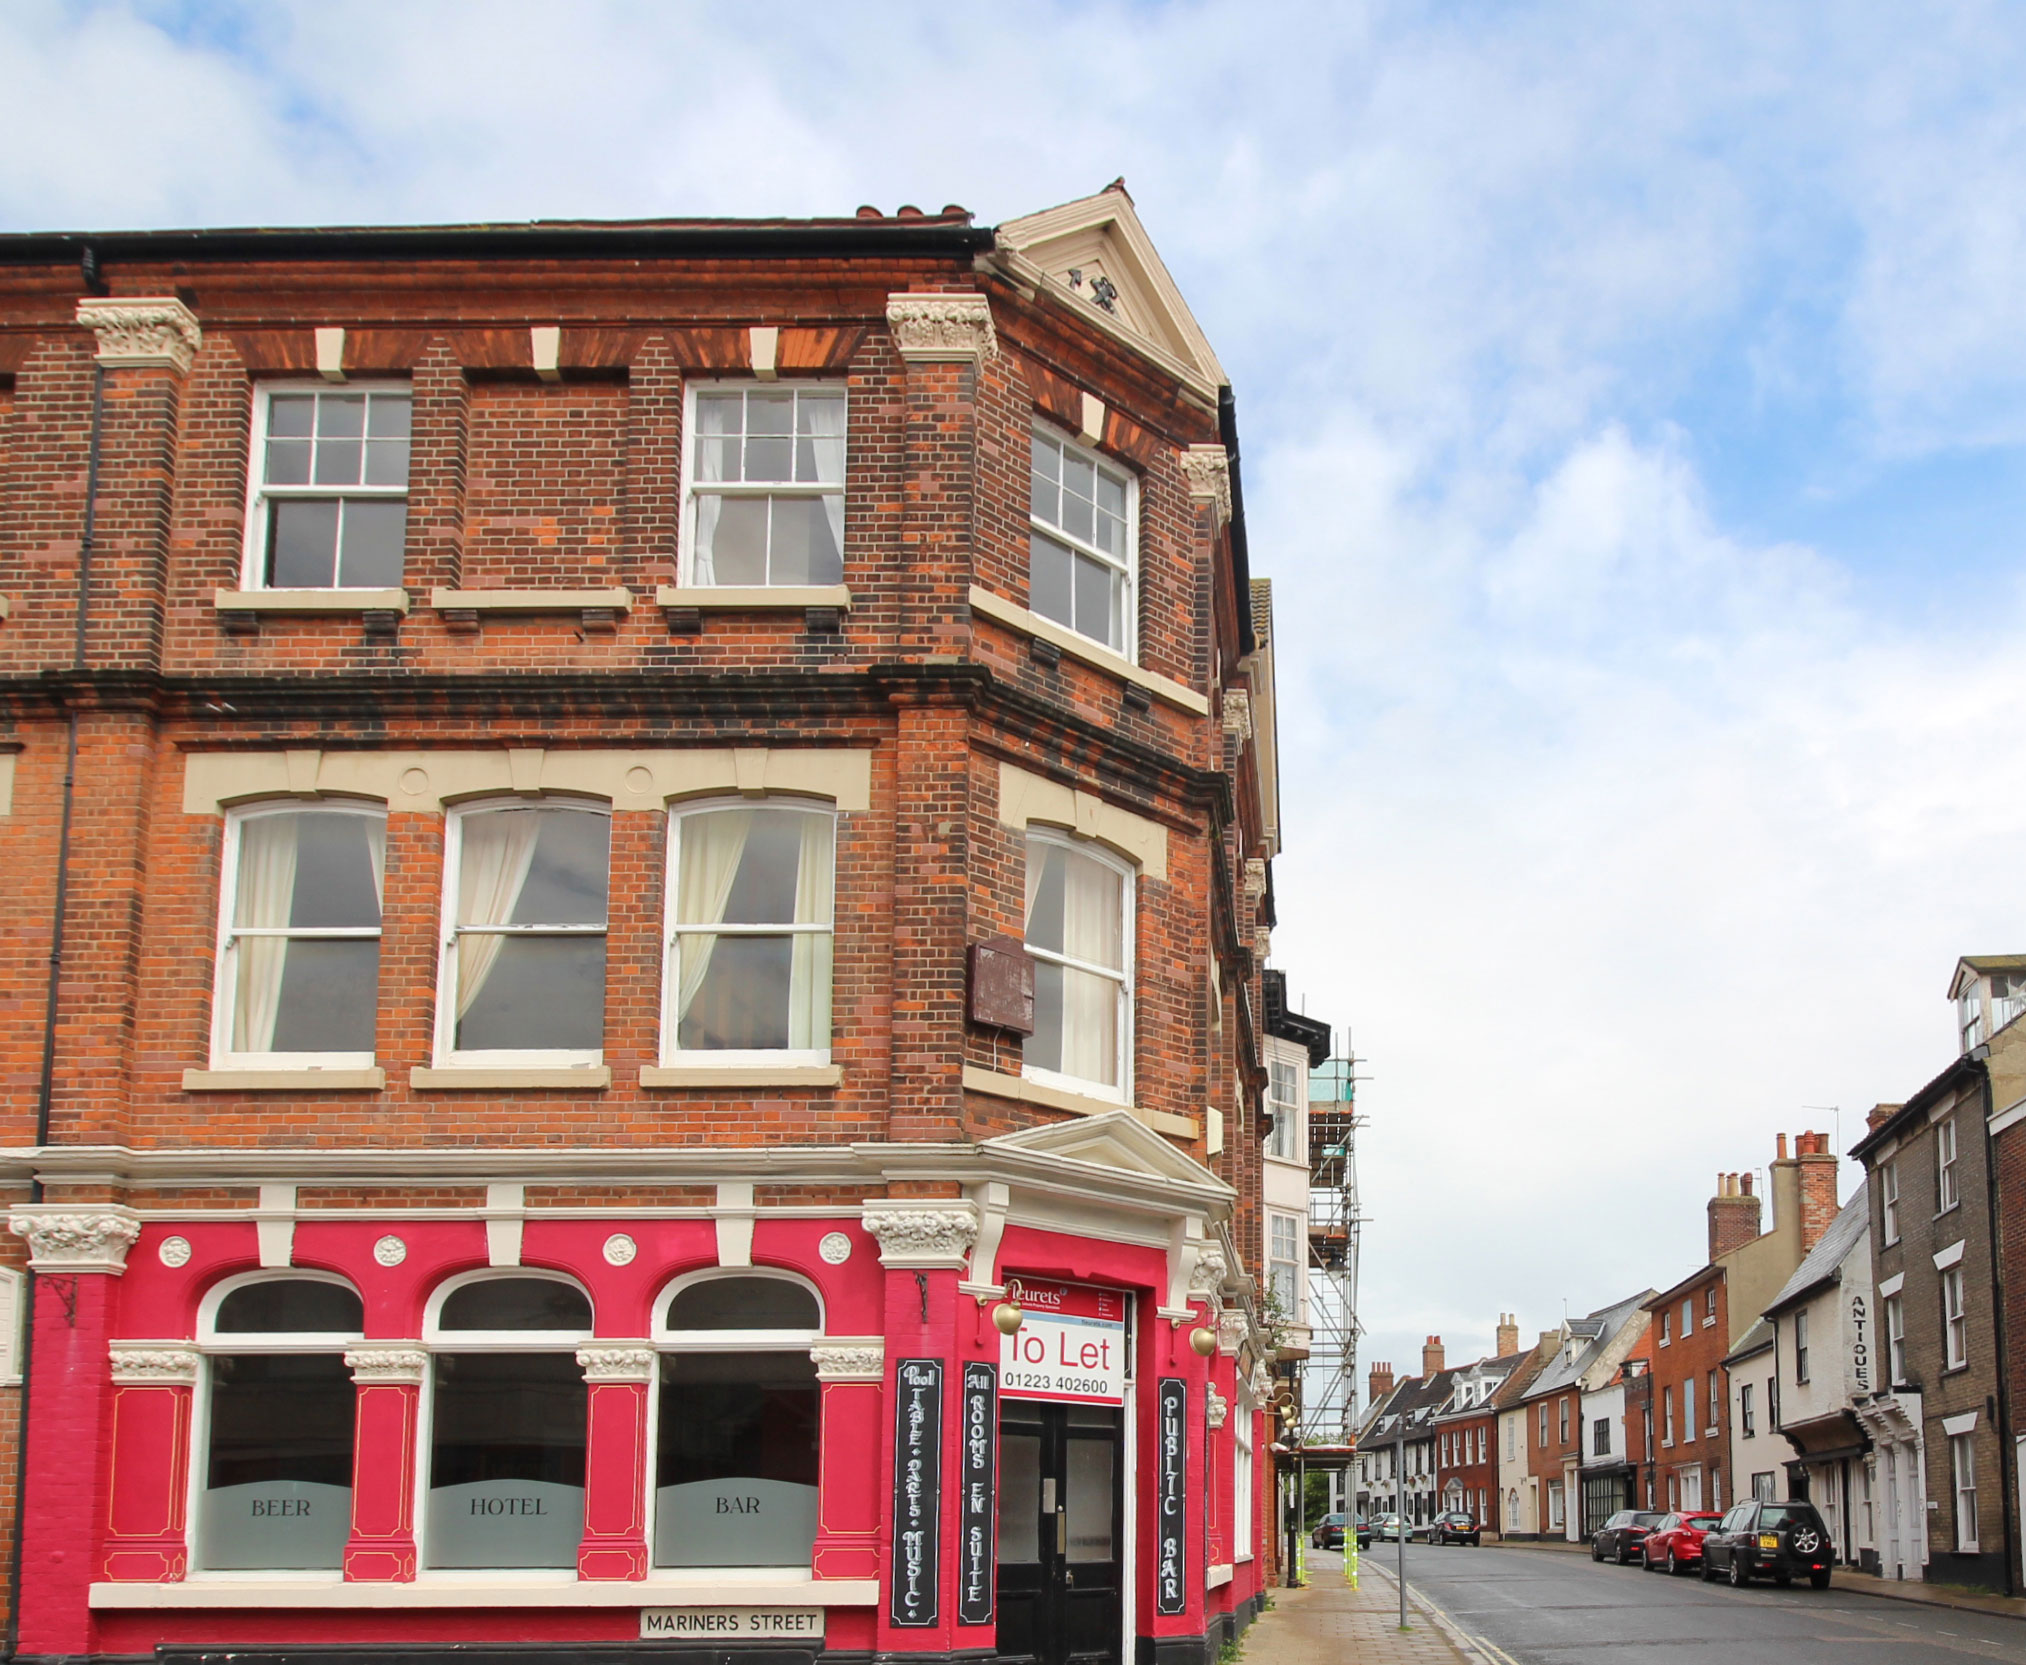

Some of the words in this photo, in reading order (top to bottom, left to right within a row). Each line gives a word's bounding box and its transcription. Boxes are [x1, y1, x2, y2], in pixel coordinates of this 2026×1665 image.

[1011, 1327, 1045, 1364] To
[1060, 1331, 1110, 1371] Let
[1852, 1296, 1869, 1391] ANTIQUES
[903, 1365, 936, 1386] Pool
[967, 1374, 990, 1390] All
[1005, 1372, 1051, 1389] 01223
[1056, 1376, 1108, 1394] 402600
[908, 1387, 926, 1446] TABLE
[968, 1395, 988, 1469] ROOMS
[1164, 1396, 1180, 1516] PUBLIC
[252, 1499, 311, 1517] BEER
[470, 1498, 548, 1516] HOTEL
[716, 1496, 760, 1514] BAR
[905, 1459, 922, 1517] DARTS
[970, 1482, 985, 1514] EN
[902, 1530, 925, 1607] MUSIC
[967, 1526, 984, 1602] SUITE
[1161, 1537, 1179, 1600] BAR
[647, 1614, 739, 1631] MARINERS
[750, 1614, 817, 1631] STREET
